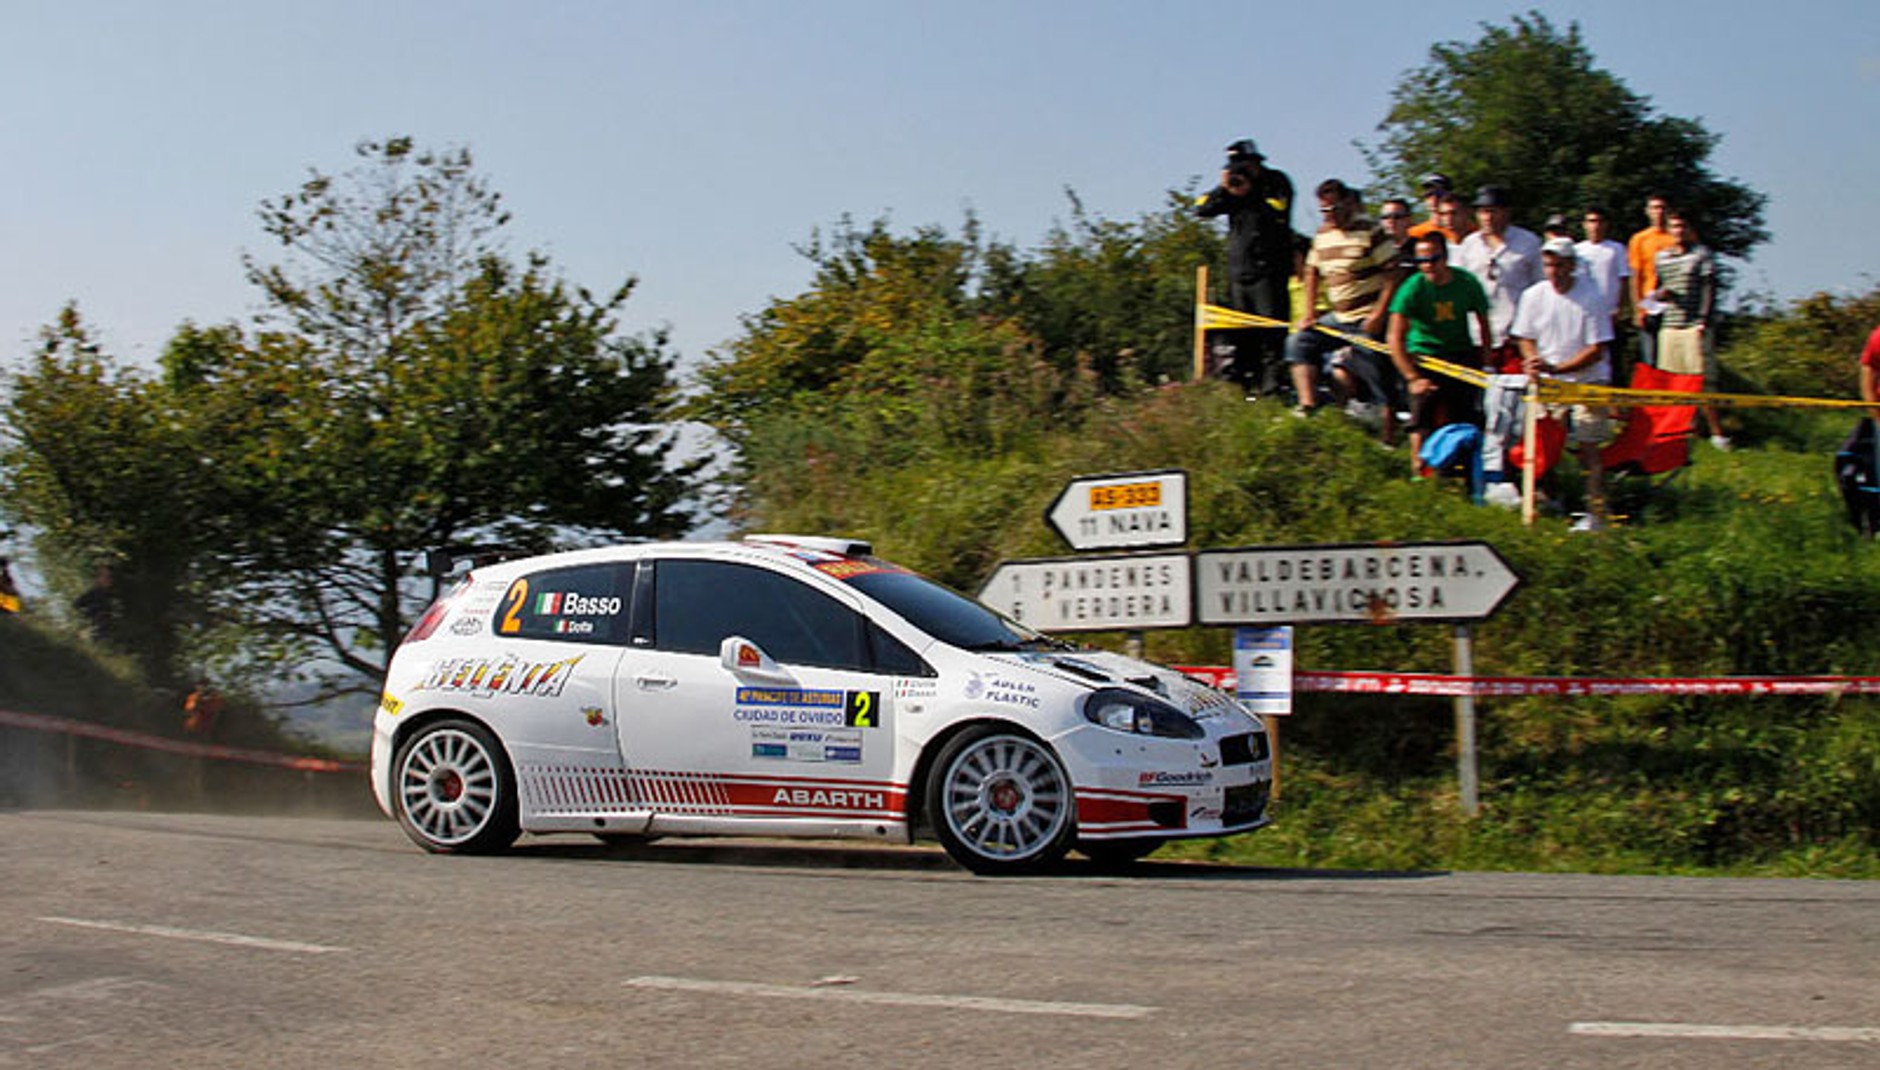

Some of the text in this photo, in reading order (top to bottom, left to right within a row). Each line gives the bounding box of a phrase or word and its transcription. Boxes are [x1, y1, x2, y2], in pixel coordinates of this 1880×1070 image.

[1109, 511, 1170, 534] NAVA
[501, 578, 529, 633] 2
[563, 592, 622, 616] Basso
[1059, 594, 1170, 619] VERDERA
[854, 691, 872, 727] 2
[984, 691, 1040, 709] PLASTIC
[780, 711, 797, 724] DE
[773, 788, 884, 809] ABARTH
